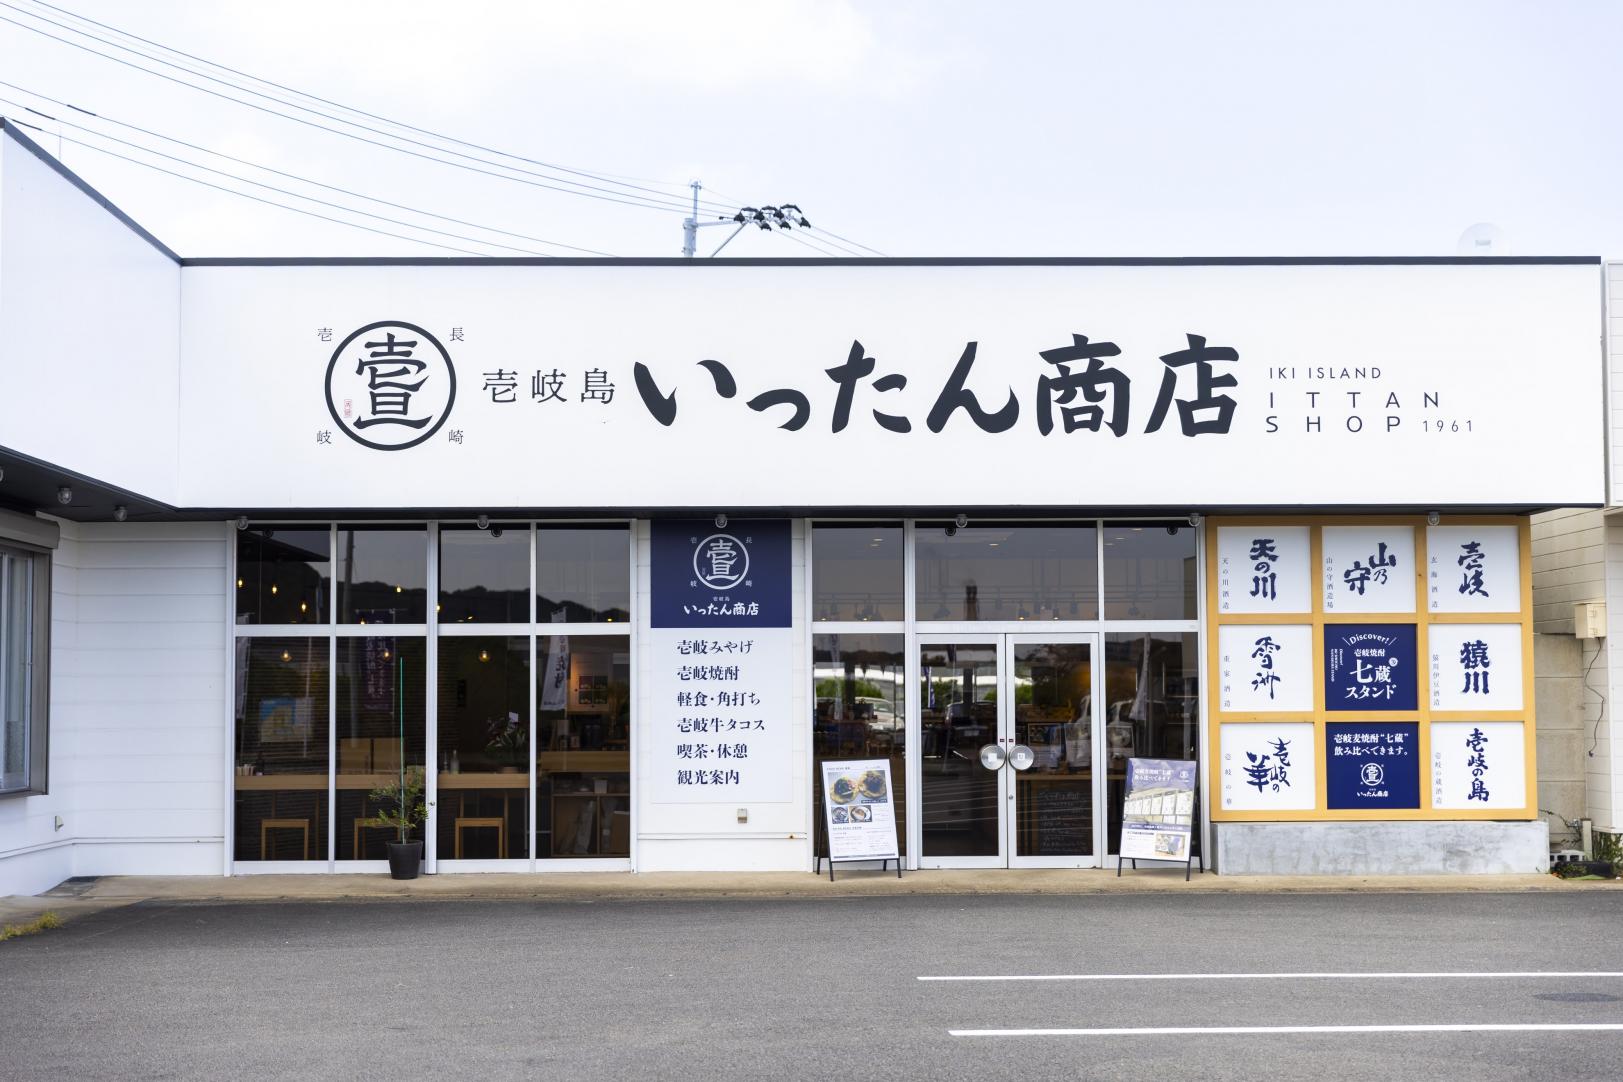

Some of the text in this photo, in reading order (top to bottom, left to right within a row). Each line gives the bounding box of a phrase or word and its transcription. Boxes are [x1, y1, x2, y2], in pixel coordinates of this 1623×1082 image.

[318, 328, 332, 341] 壱
[450, 328, 464, 341] 長
[1270, 368, 1380, 379] IKI ISLAND
[483, 368, 615, 404] 壱岐島
[634, 333, 1239, 437] いったん商店
[1270, 392, 1438, 408] ITTAN
[1266, 416, 1471, 432] SHOP 1961
[317, 430, 331, 444] 岐
[1250, 539, 1279, 600] 天の川
[684, 600, 758, 615] いったん商店
[1349, 631, 1390, 646] Discover!
[677, 640, 753, 654] 壱岐みやげ
[678, 666, 739, 680] 壱岐焼酎
[1349, 658, 1391, 684] 七蔵
[1460, 640, 1490, 694] 猿川
[678, 692, 760, 706] 軽食・角打ち
[1345, 685, 1396, 699] スタンド
[678, 718, 764, 732] 壱岐牛タコス
[678, 744, 747, 758] 喫茶・休憩
[1466, 728, 1489, 801] 壱岐の島
[678, 770, 739, 784] 観光案内
